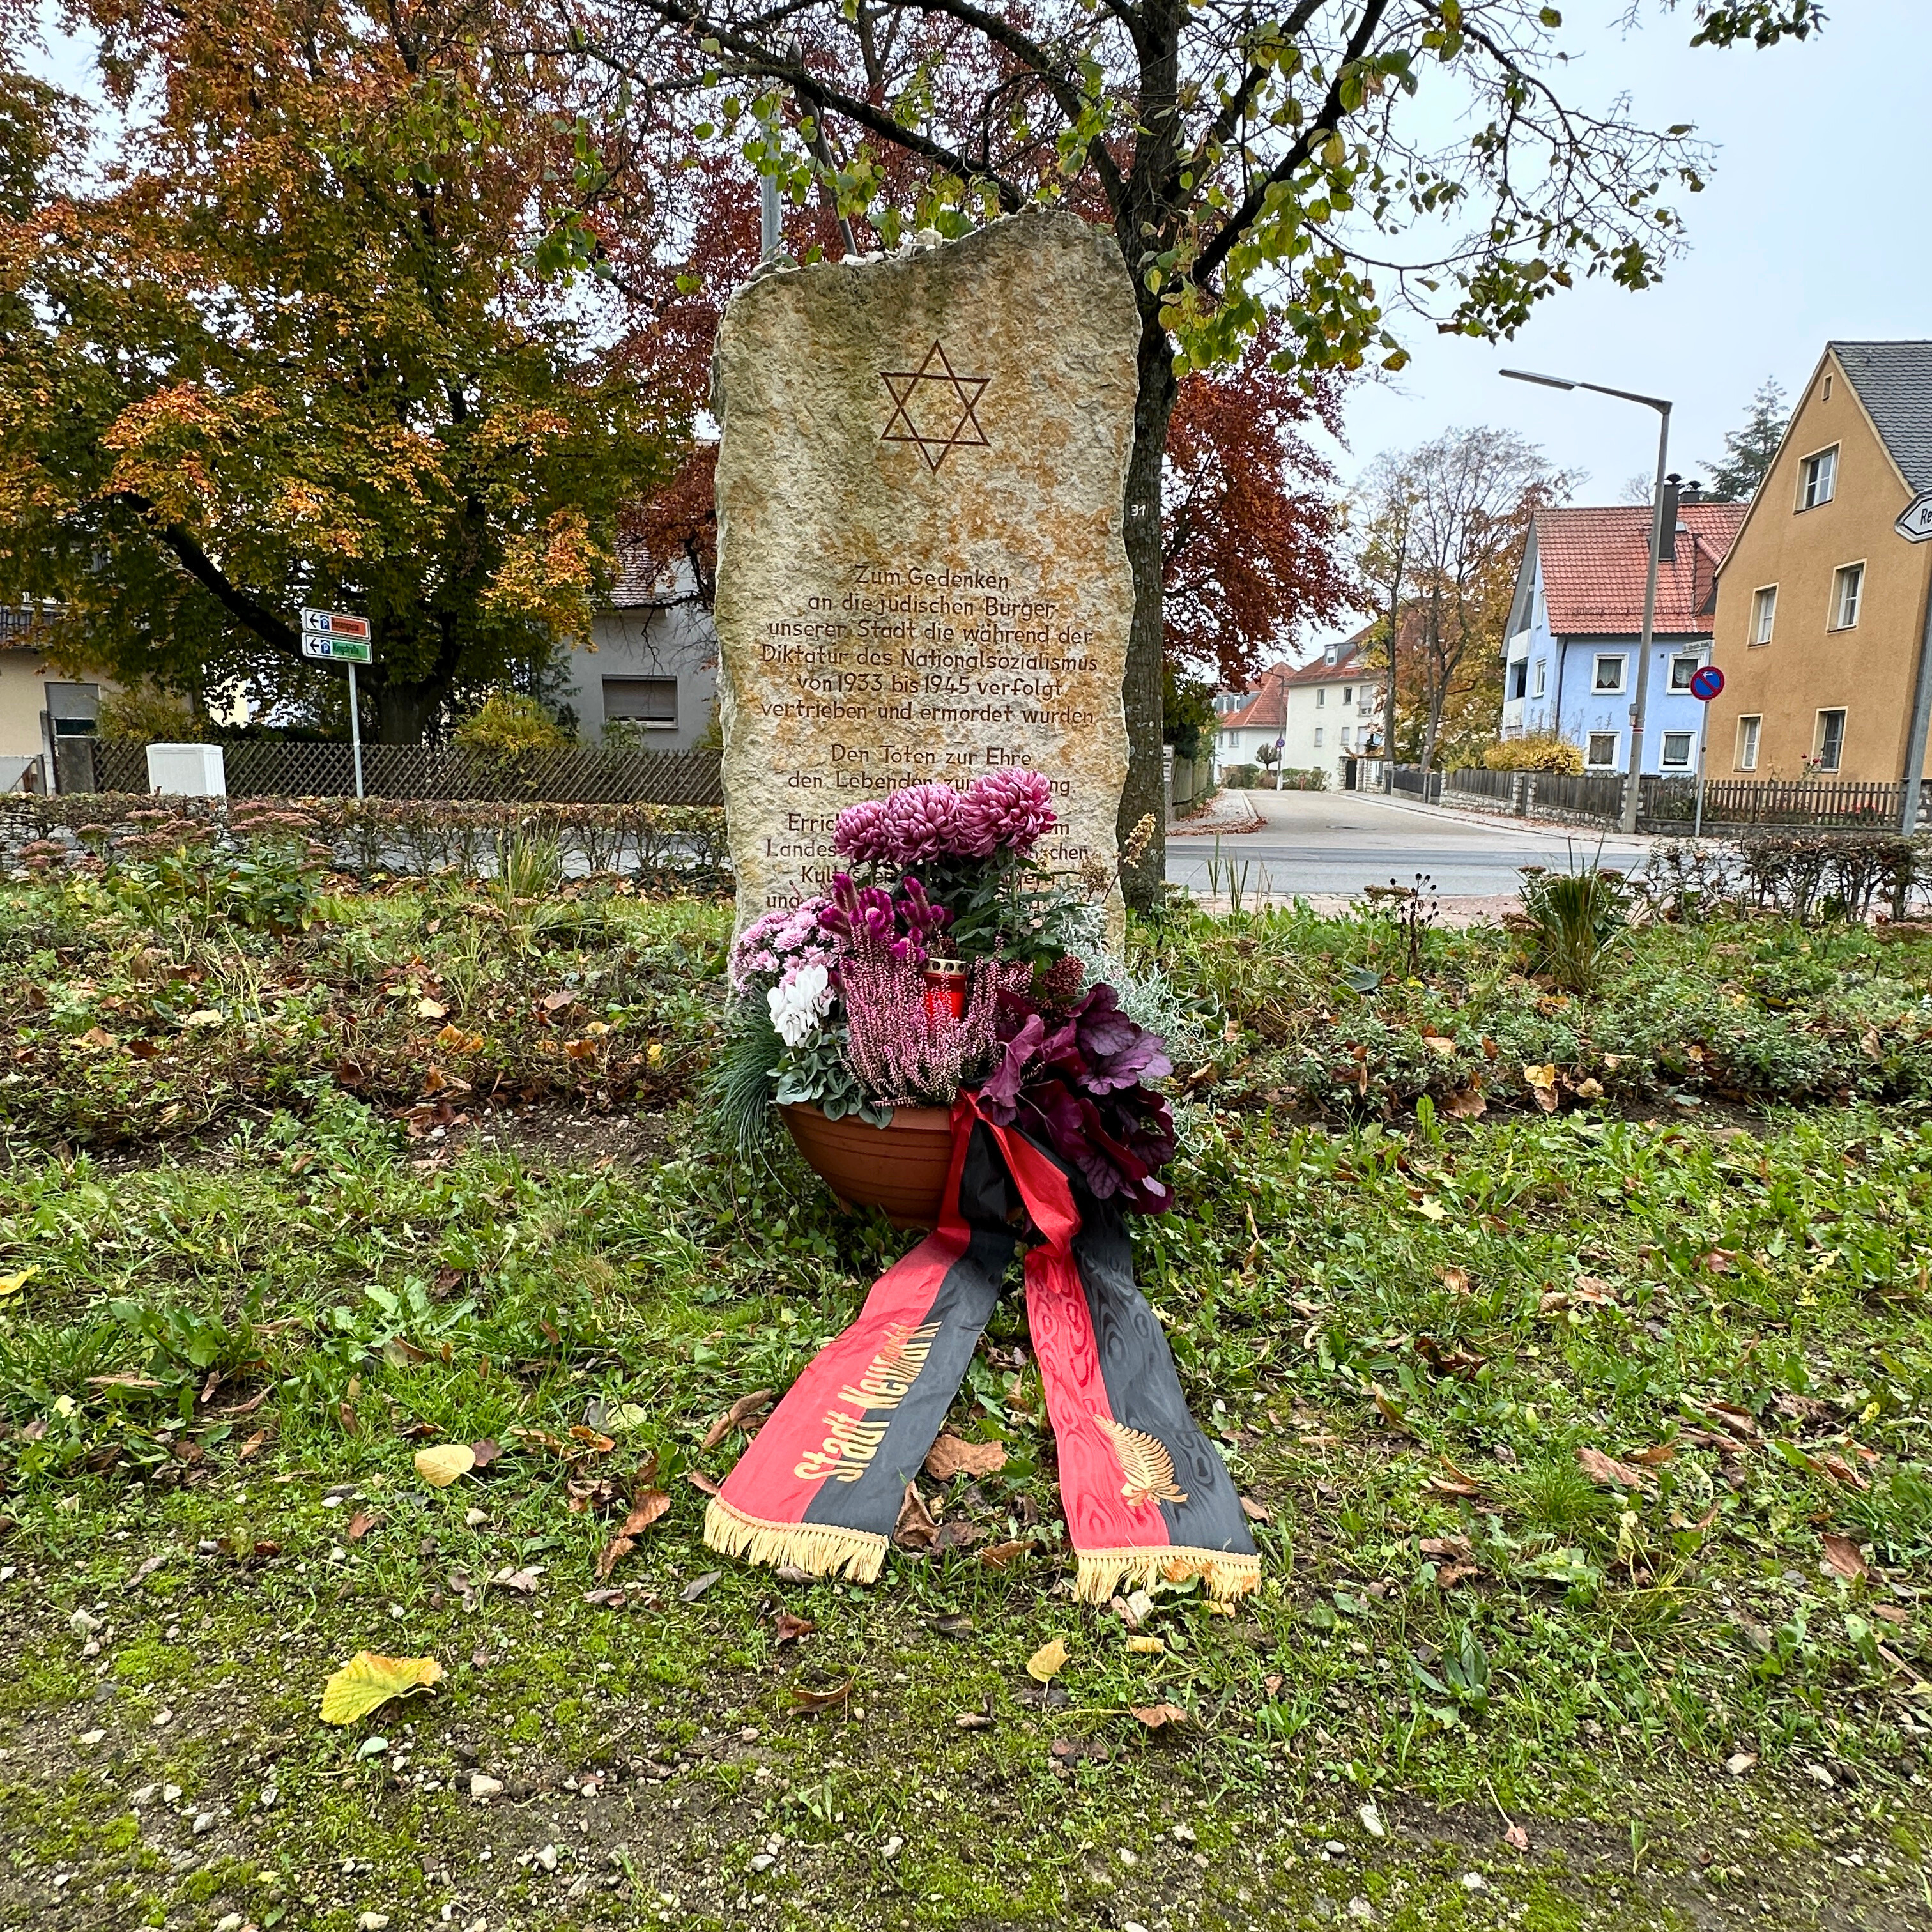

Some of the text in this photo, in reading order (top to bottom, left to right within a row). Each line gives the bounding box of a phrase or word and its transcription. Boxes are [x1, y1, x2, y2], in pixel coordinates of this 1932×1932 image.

[1131, 504, 1146, 516] 31
[854, 564, 1009, 590] Zum Gedenken
[808, 592, 1056, 621] an die jüdischen Bürger
[769, 620, 1094, 645] unserer Stadt die während der
[762, 644, 1098, 671] Diktatur des Nationalsozialismus
[797, 673, 1063, 702] von 1933 bis 1945 verfolgt
[760, 700, 1094, 724] vertrieben und ermordet wurden
[831, 744, 1032, 766] Den Toten zur Ehre
[788, 770, 823, 789] den
[793, 1409, 891, 1483] Stadt
